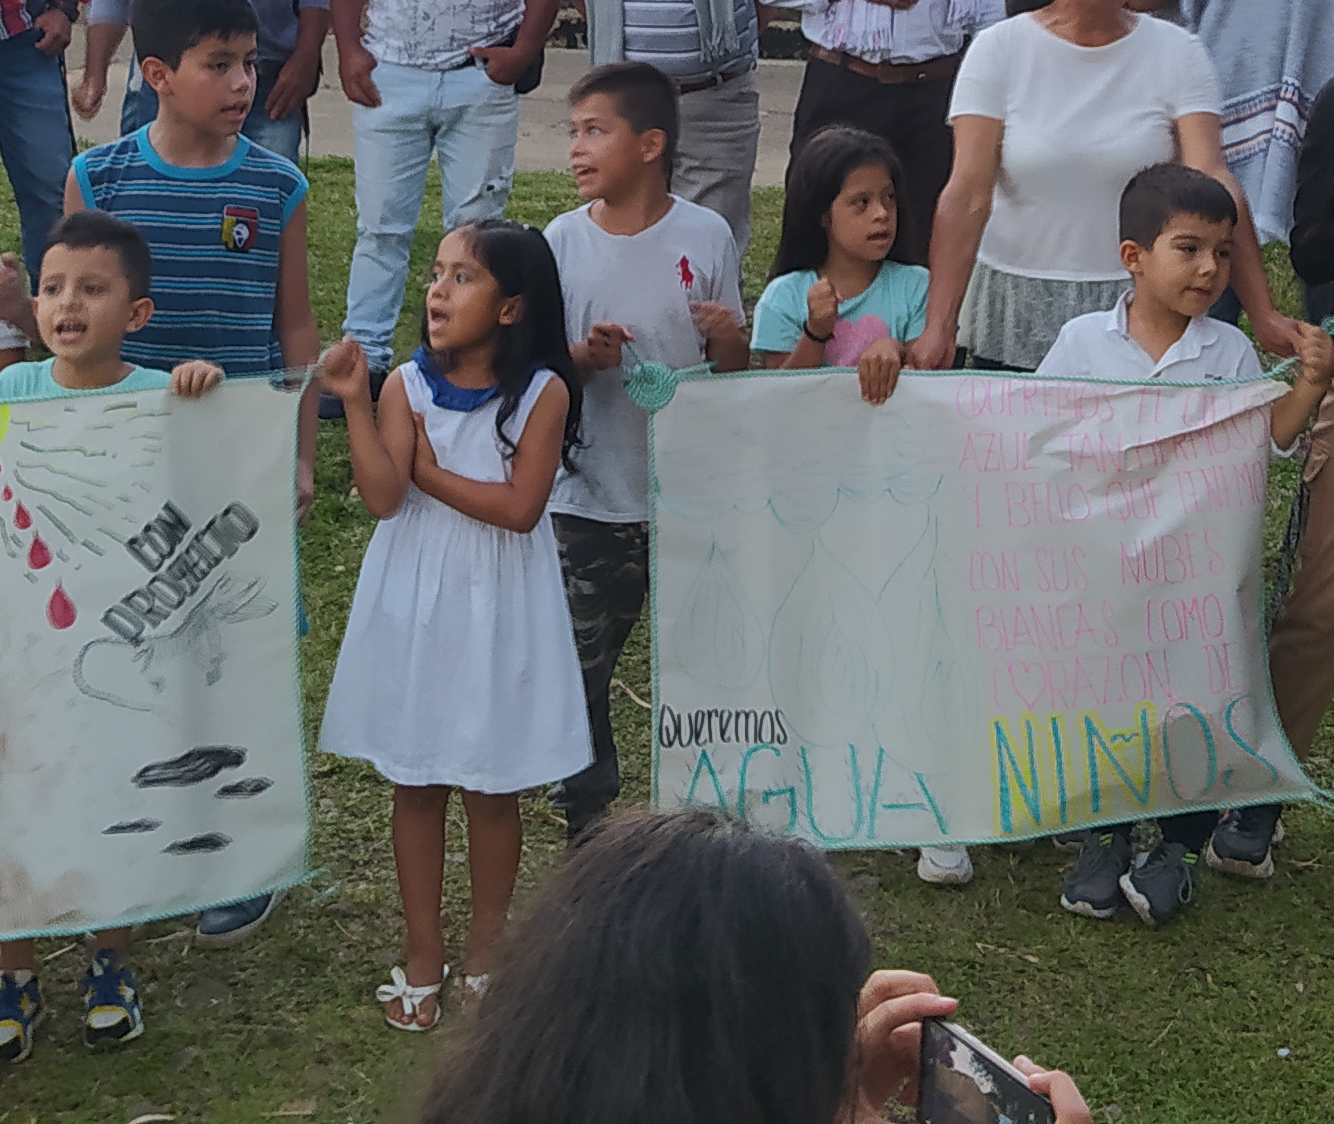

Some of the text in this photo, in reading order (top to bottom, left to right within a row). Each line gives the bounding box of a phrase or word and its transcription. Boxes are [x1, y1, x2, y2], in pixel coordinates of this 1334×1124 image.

[955, 380, 1116, 423] QUEREMOS
[958, 432, 1039, 474] AZUL
[1065, 433, 1124, 474] TAN
[961, 483, 982, 529] Y
[1005, 481, 1093, 528] BELLO
[1106, 476, 1160, 522] QUE
[124, 498, 194, 573] CON
[969, 528, 1226, 593] CON SUS NUBES
[975, 593, 1225, 652] BLANCAS COMO
[1203, 642, 1246, 695] DE
[658, 704, 789, 748] Queremos
[685, 743, 948, 842] AGUA
[992, 695, 1281, 834] NIÑOS
